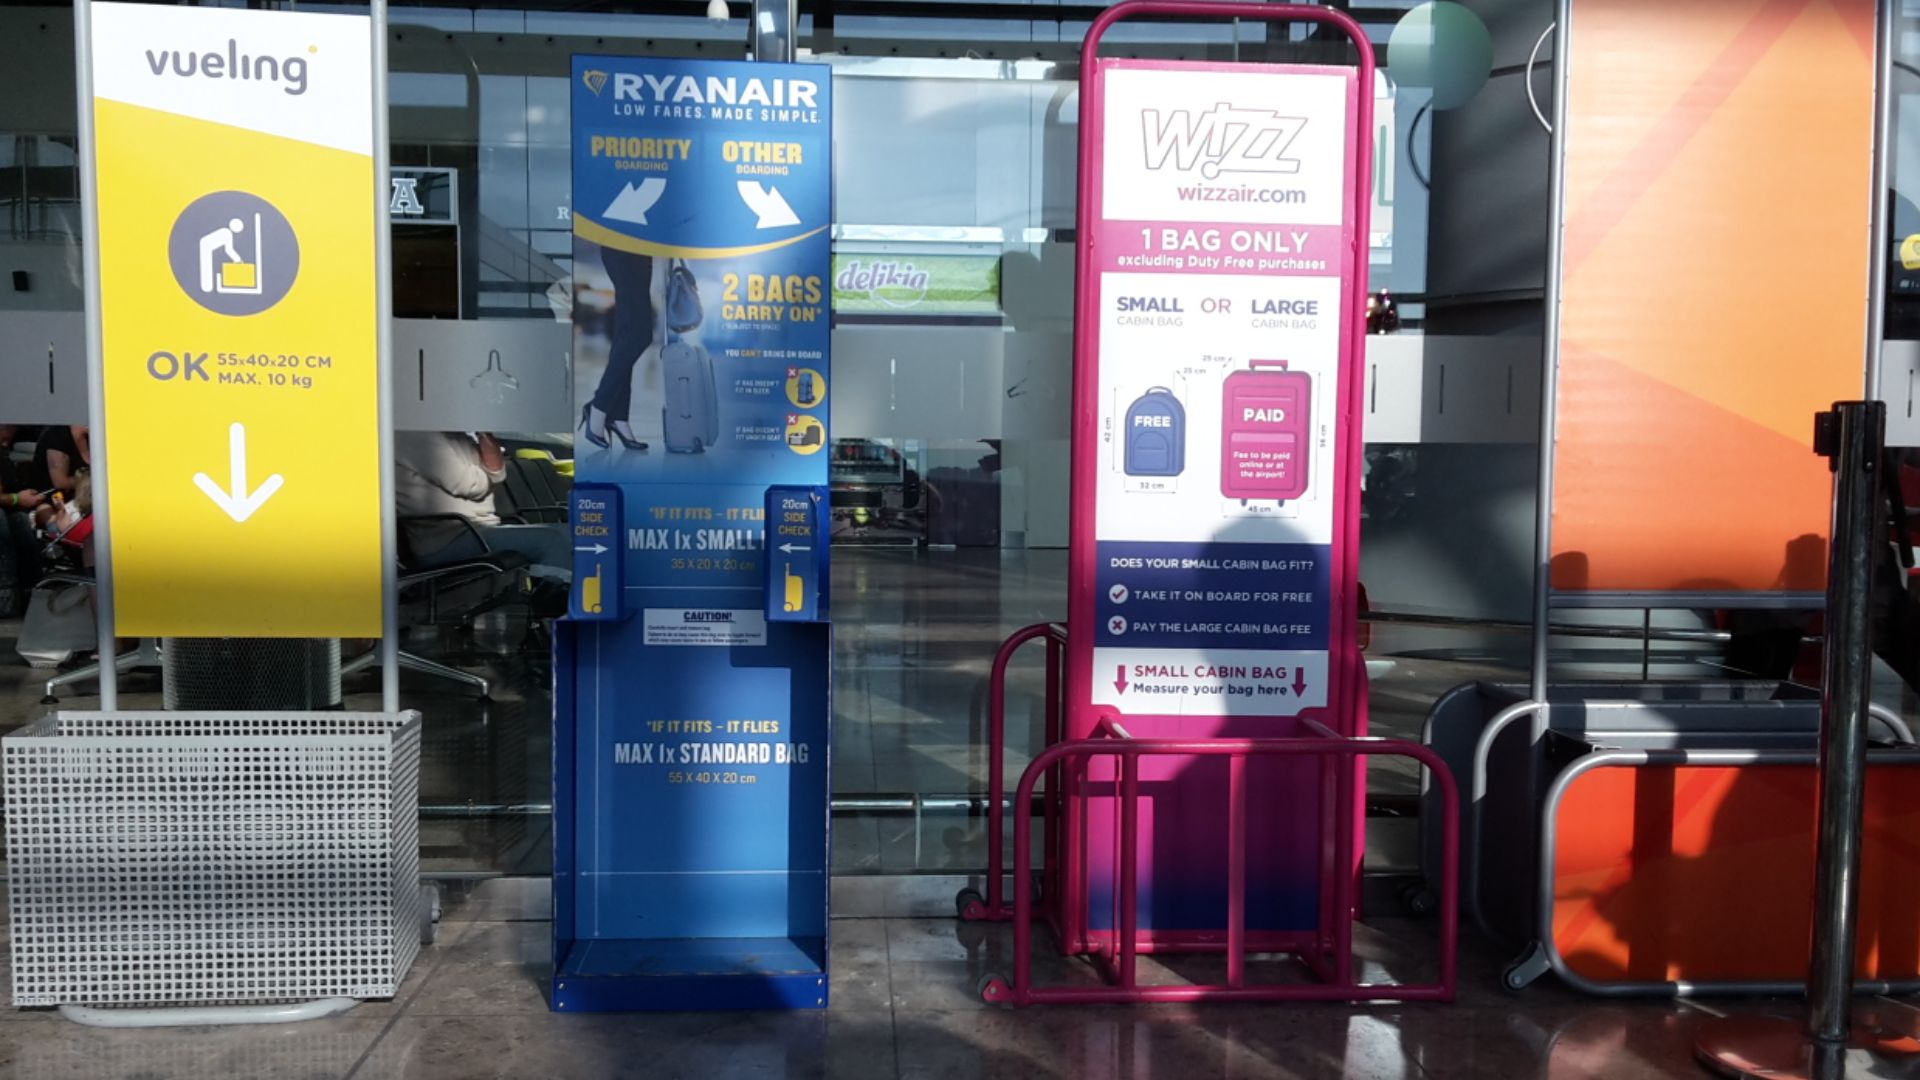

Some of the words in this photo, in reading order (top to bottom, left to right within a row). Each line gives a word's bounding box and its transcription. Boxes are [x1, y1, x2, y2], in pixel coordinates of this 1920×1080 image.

[145, 38, 317, 96] vueling
[614, 72, 818, 108] RYANAIR
[614, 103, 646, 117] LOW
[654, 104, 706, 119] FARES.
[712, 107, 754, 121] MADE
[761, 109, 822, 124] SIMPLE.
[591, 135, 692, 160] PRIORITY
[722, 140, 803, 165] OTHER
[615, 160, 669, 172] BOARDING
[736, 165, 789, 176] BOARDING
[1177, 182, 1307, 204] wizzair.com
[1141, 228, 1152, 250] 1
[1161, 228, 1222, 252] BAG
[1231, 230, 1309, 254] ONLY
[1118, 254, 1184, 269] excluding
[1188, 255, 1220, 270] Duty
[1224, 256, 1254, 269] Free
[1258, 257, 1327, 271] purchases
[837, 262, 928, 291] delikia
[722, 273, 740, 302] 2
[748, 274, 822, 305] BAGS
[1117, 296, 1184, 313] SMALL
[1200, 297, 1232, 313] OR
[1251, 299, 1318, 316] LARGE
[722, 304, 784, 322] CARRY
[1117, 315, 1155, 326] CABIN
[1157, 316, 1184, 327] BAG
[1251, 318, 1289, 329] CABIN
[1291, 319, 1317, 330] BAG
[217, 353, 300, 368] 55x40x20
[305, 355, 332, 368] CM
[725, 349, 740, 358] YOU
[763, 350, 785, 358] BRING
[786, 350, 797, 359] ON
[798, 350, 822, 359] BOARD
[147, 351, 210, 381] OK
[218, 372, 262, 385] MAX.
[268, 373, 286, 385] 10
[292, 373, 312, 388] kg
[1134, 415, 1171, 428] FREE
[1243, 408, 1285, 423] PAID
[1233, 451, 1248, 460] Fee
[1250, 452, 1259, 460] to
[1261, 452, 1272, 460] be
[1273, 452, 1291, 462] paid
[1239, 461, 1263, 469] online
[1275, 461, 1285, 469] at
[1240, 470, 1254, 478] the
[1255, 470, 1286, 480] airport!
[578, 499, 605, 510] 20cm
[781, 499, 808, 510] 20cm
[580, 512, 603, 523] SIDE
[669, 508, 682, 520] IT
[685, 508, 712, 520] FITS
[726, 508, 738, 520] IT
[783, 512, 806, 523] SIDE
[575, 525, 609, 537] CHECK
[778, 525, 811, 536] CHECK
[628, 528, 668, 550] MAX
[696, 529, 757, 551] SMALL
[671, 558, 685, 570] 35
[698, 558, 712, 570] 20
[723, 558, 737, 571] 20
[1111, 557, 1143, 568] DOES
[1146, 558, 1179, 569] YOUR
[1181, 559, 1220, 569] SMALL
[1223, 560, 1259, 570] CABIN
[1261, 560, 1287, 570] BAG
[1289, 561, 1314, 571] FIT?
[1134, 590, 1166, 600] TAKE
[1170, 590, 1180, 600] IT
[1184, 591, 1202, 601] ON
[1206, 591, 1251, 602] BOARD
[1254, 592, 1279, 602] FOR
[1282, 592, 1313, 603] FREE
[683, 611, 733, 621] CAUTION!
[1133, 622, 1157, 632] PAY
[1160, 622, 1180, 633] THE
[1183, 623, 1222, 634] LARGE
[1224, 623, 1259, 634] CABIN
[1262, 624, 1288, 634] BAG
[1290, 624, 1312, 634] FEE
[1134, 665, 1188, 678] SMALL
[1194, 665, 1248, 679] CABIN
[1252, 666, 1288, 679] BAG
[1133, 683, 1189, 694] Measure
[1193, 684, 1224, 697] your
[1228, 683, 1253, 698] bag
[1258, 683, 1288, 696] here
[668, 720, 681, 733] IT
[684, 720, 712, 733] FITS
[727, 721, 739, 733] IT
[743, 721, 779, 733] FLIES
[615, 743, 654, 764] MAX
[680, 743, 770, 764] STANDARD
[775, 743, 809, 764] BAG
[668, 772, 683, 784] 55
[696, 772, 710, 784] 40
[723, 773, 737, 784] 20
[740, 775, 756, 784] cm
